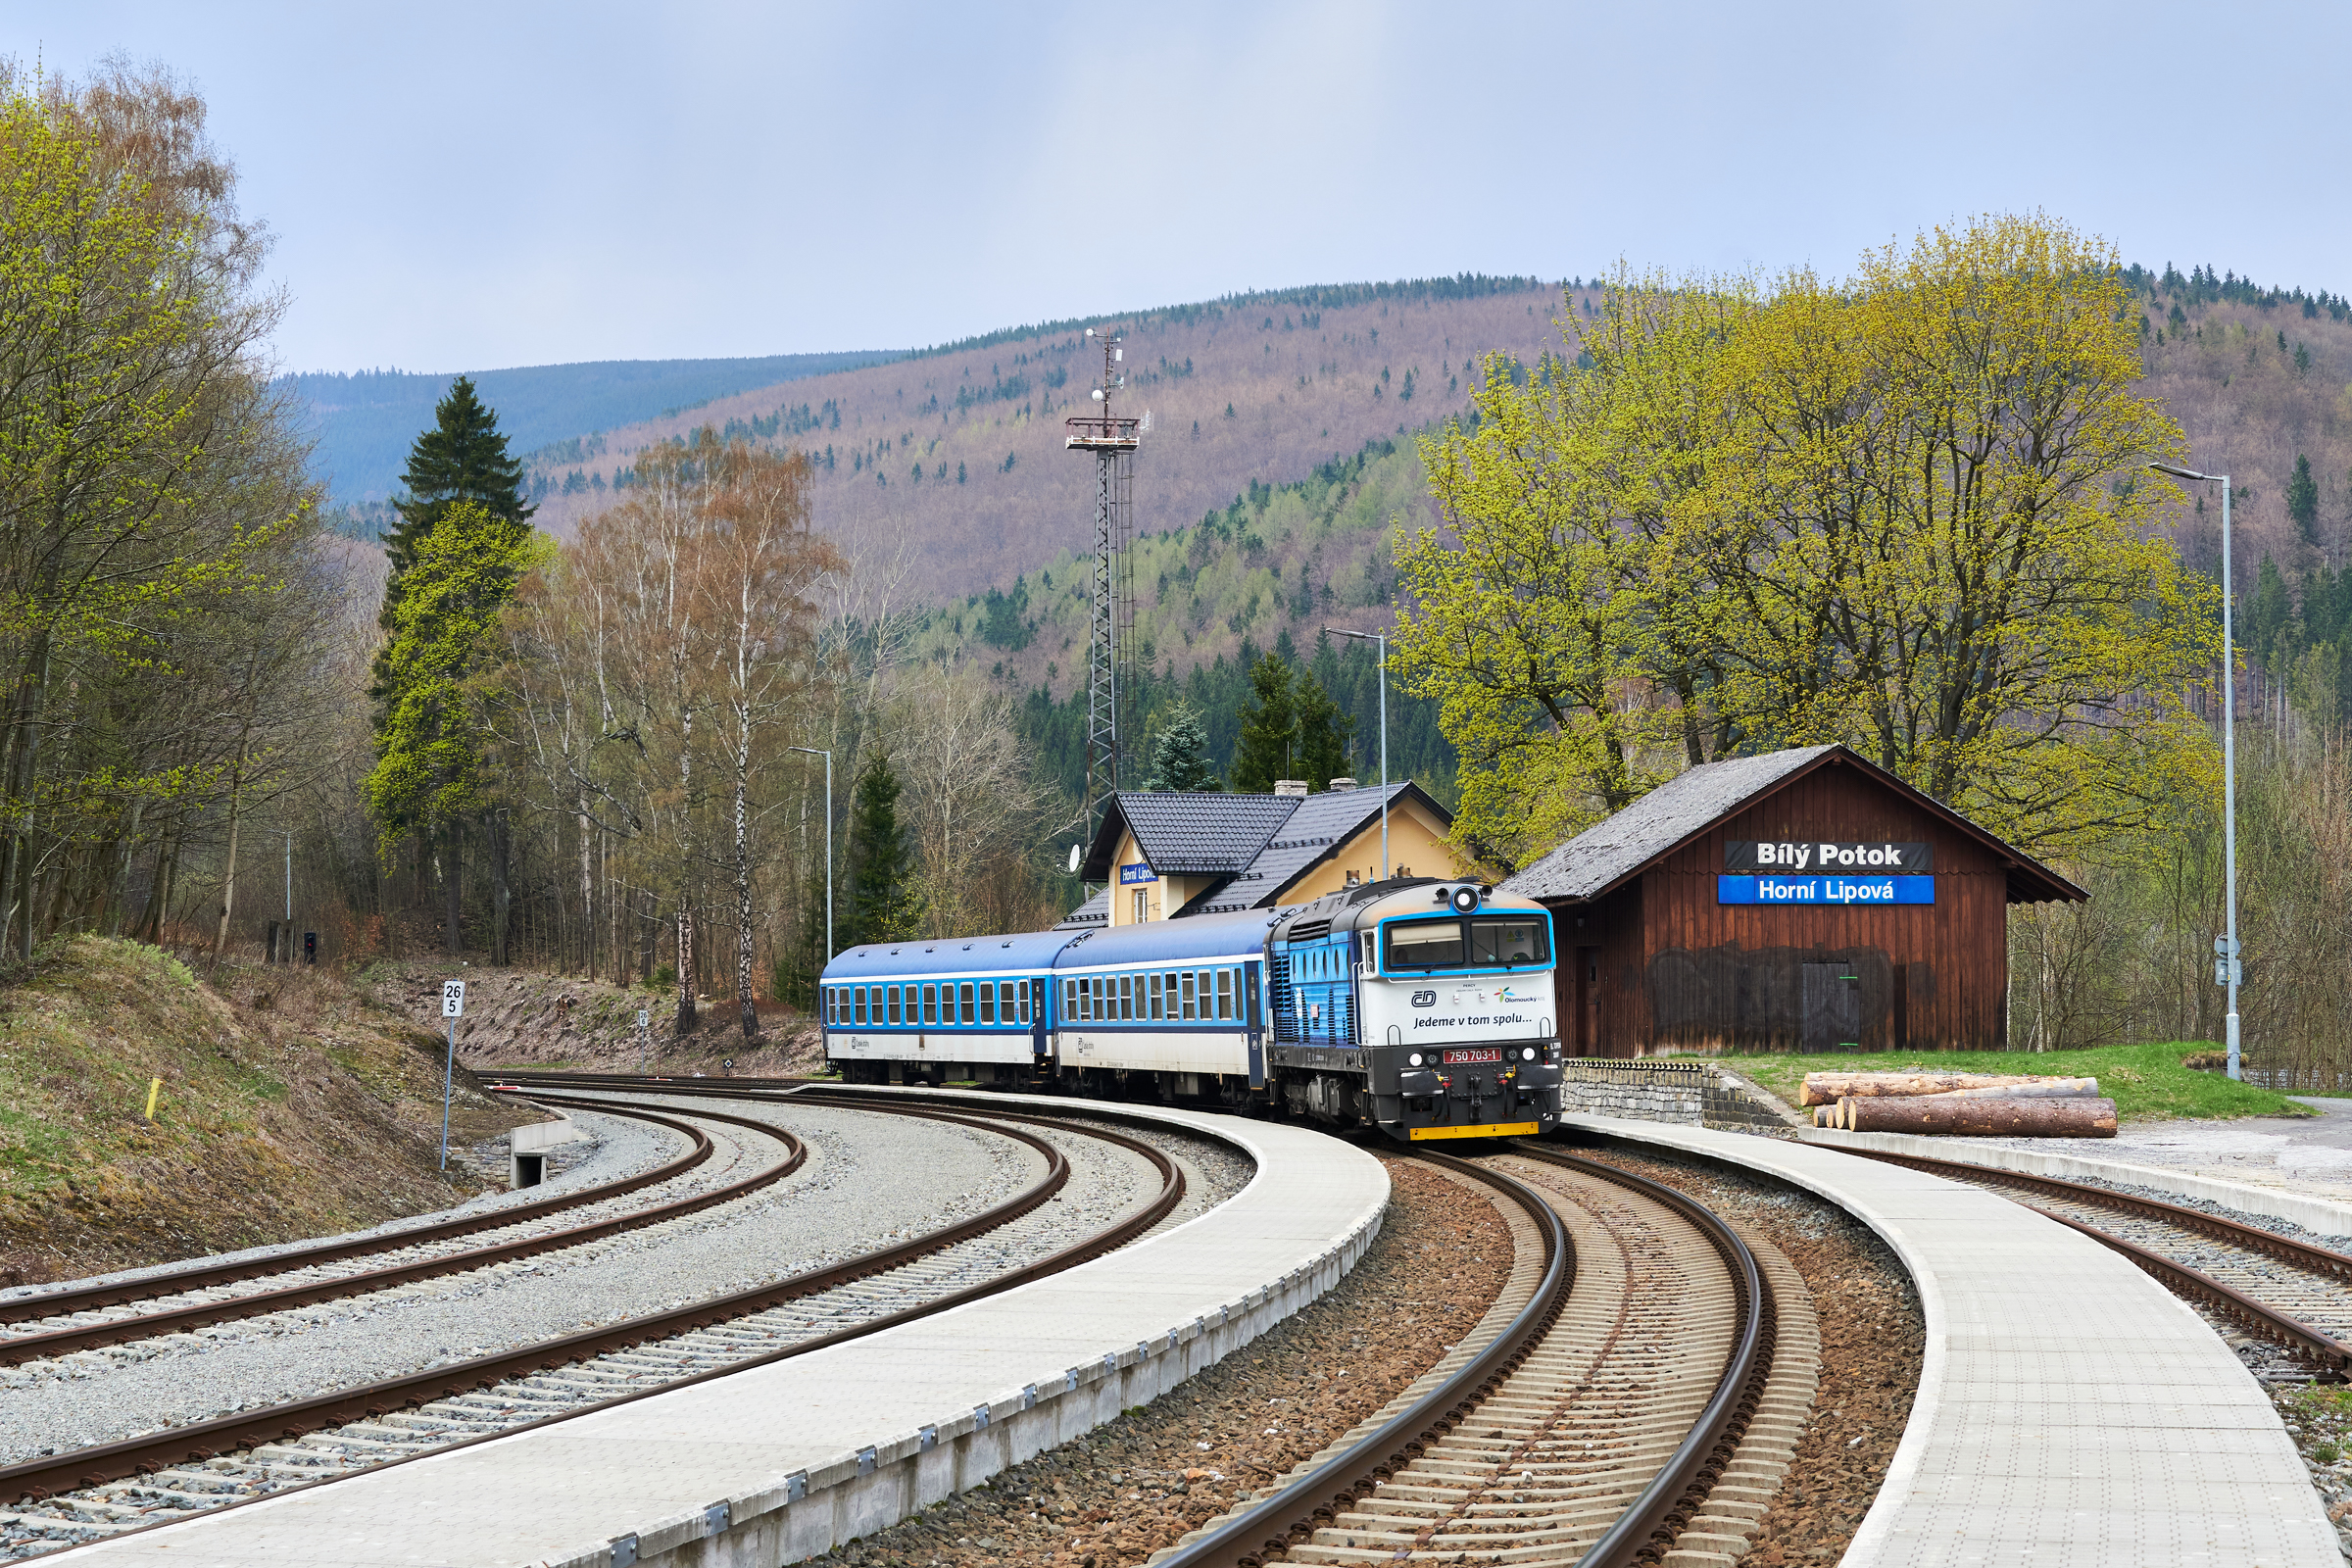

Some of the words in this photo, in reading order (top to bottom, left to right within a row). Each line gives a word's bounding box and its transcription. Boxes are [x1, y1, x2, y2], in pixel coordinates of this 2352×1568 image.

[1757, 843, 1811, 869] Bílý
[1819, 844, 1902, 865] Potok
[1759, 881, 1817, 900] Horní
[1826, 881, 1893, 904] Lipová
[446, 985, 462, 998] 26
[449, 1000, 457, 1012] 5
[1413, 1016, 1455, 1029] Jedeme
[1468, 1015, 1490, 1025] tom
[1493, 1012, 1533, 1027] spolu...
[1449, 1051, 1468, 1061] 750
[1469, 1050, 1495, 1060] 703-1
